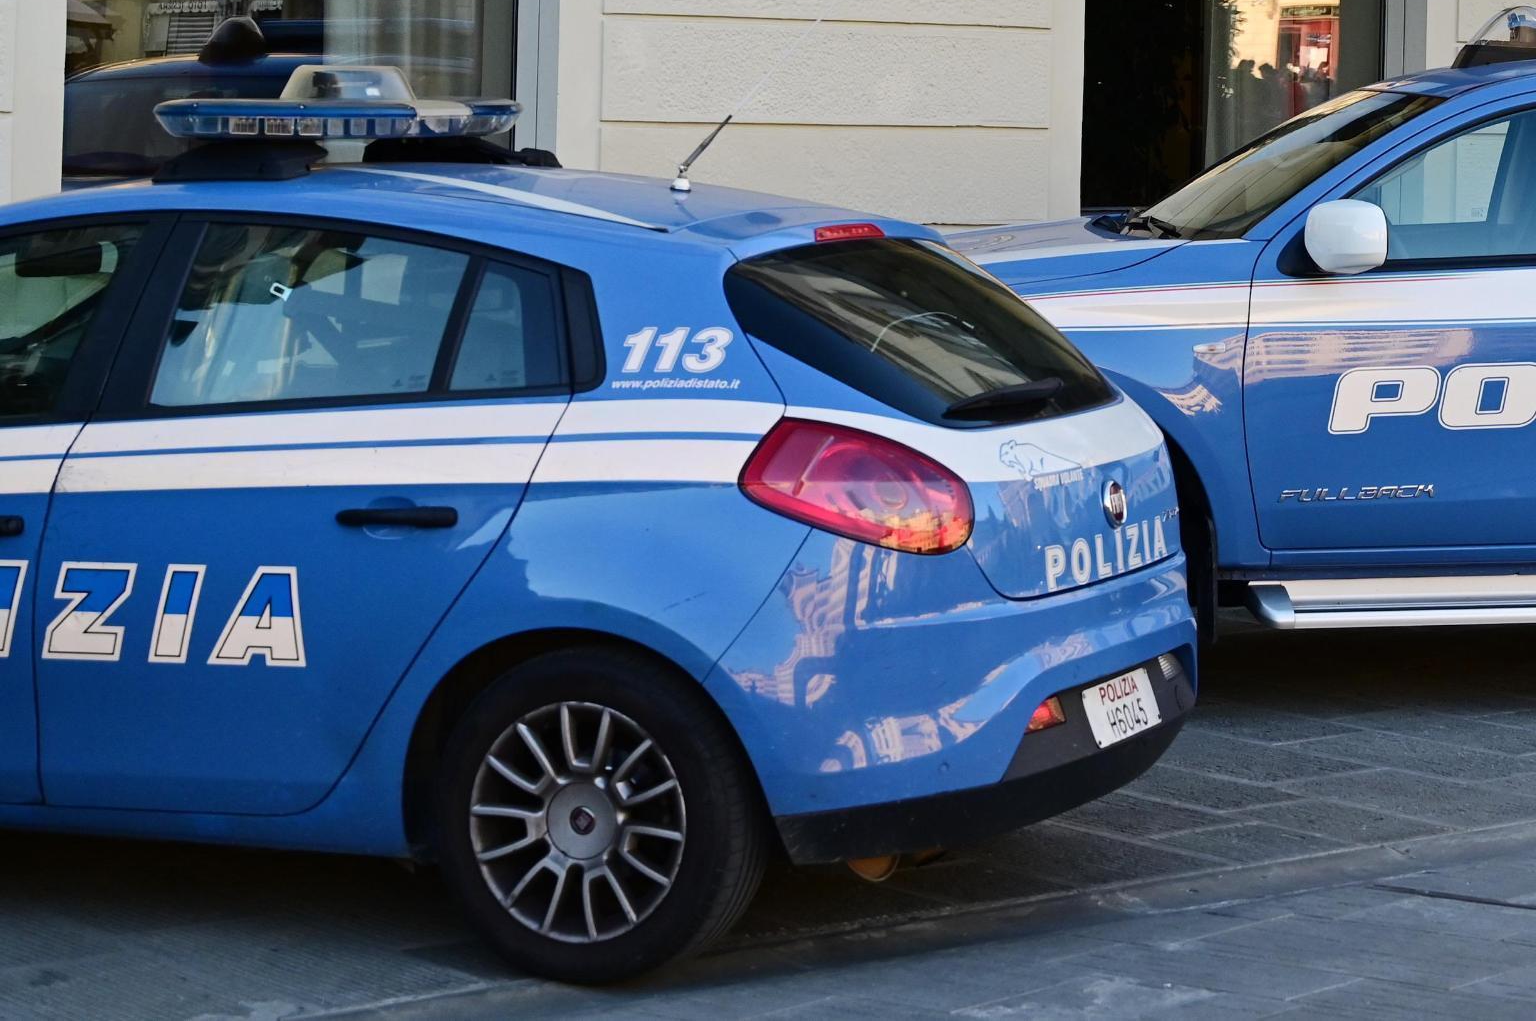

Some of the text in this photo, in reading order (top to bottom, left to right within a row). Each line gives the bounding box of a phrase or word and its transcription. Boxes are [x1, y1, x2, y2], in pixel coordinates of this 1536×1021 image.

[621, 326, 734, 374] 113
[611, 377, 741, 391] www.poliziadistato.it
[1277, 483, 1434, 504] FULLBACK
[1044, 515, 1168, 593] POLIZIA
[1098, 675, 1139, 706] POLIZIA
[1106, 697, 1149, 738] H6045
